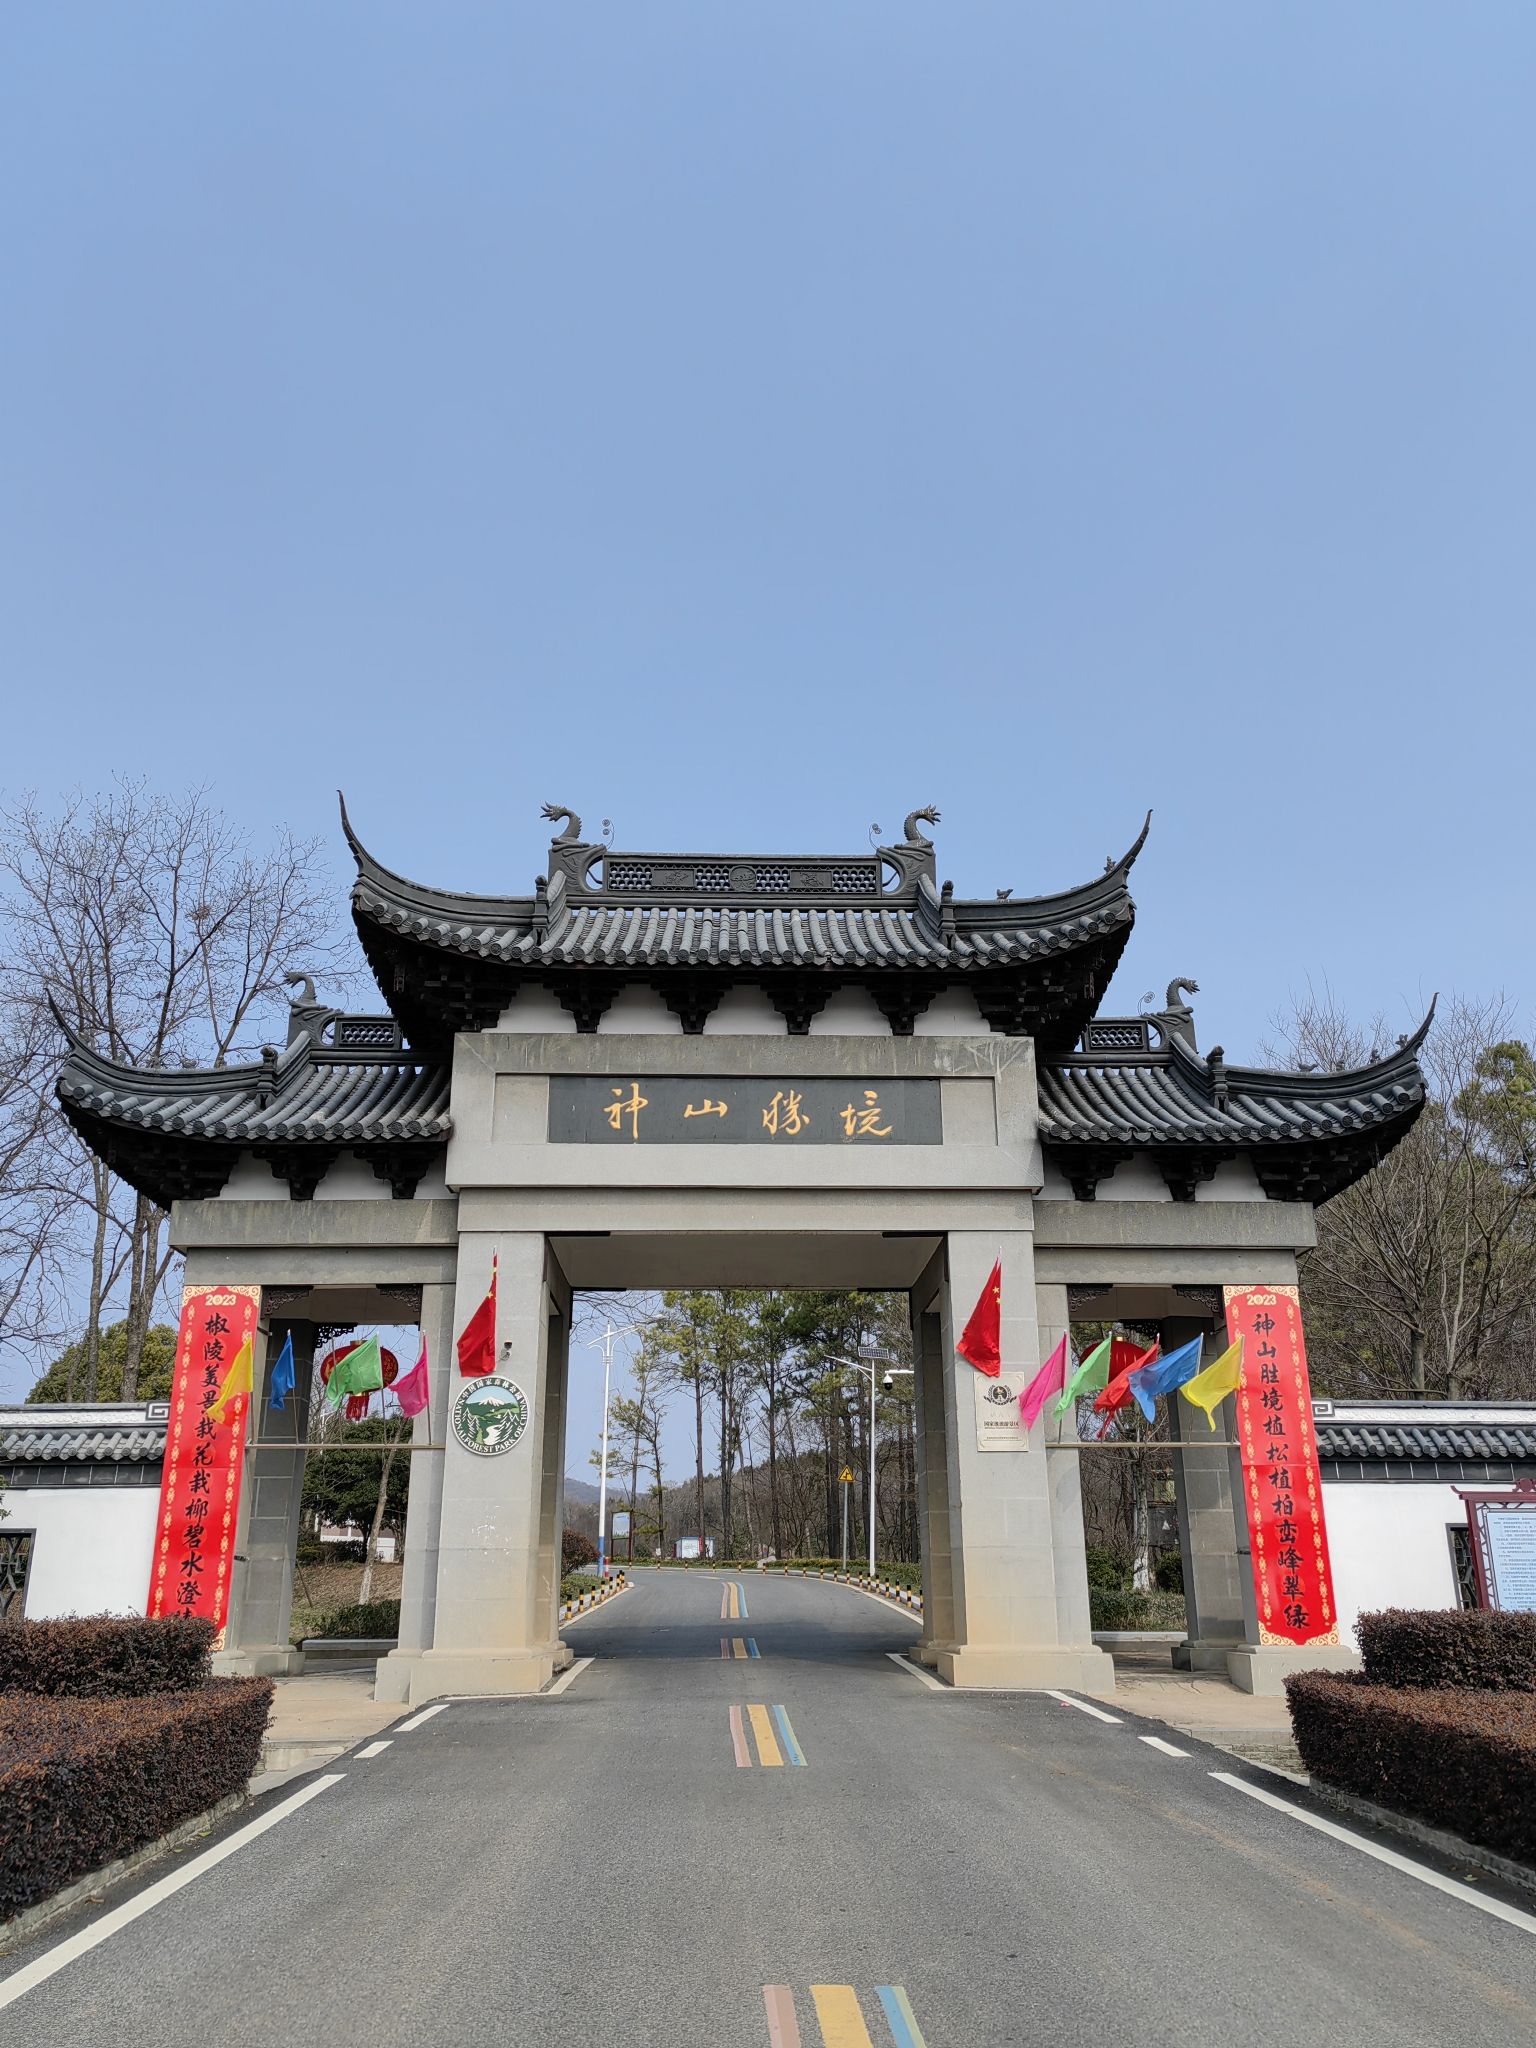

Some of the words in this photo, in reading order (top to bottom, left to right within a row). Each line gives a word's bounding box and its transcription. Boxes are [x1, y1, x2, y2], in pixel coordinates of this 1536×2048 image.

[205, 1294, 237, 1306] 2023
[1247, 1294, 1277, 1306] 2023
[464, 1437, 493, 1453] FOREST
[495, 1439, 515, 1452] PARK
[514, 1426, 524, 1438] OF
[520, 1399, 528, 1425] CHINA
